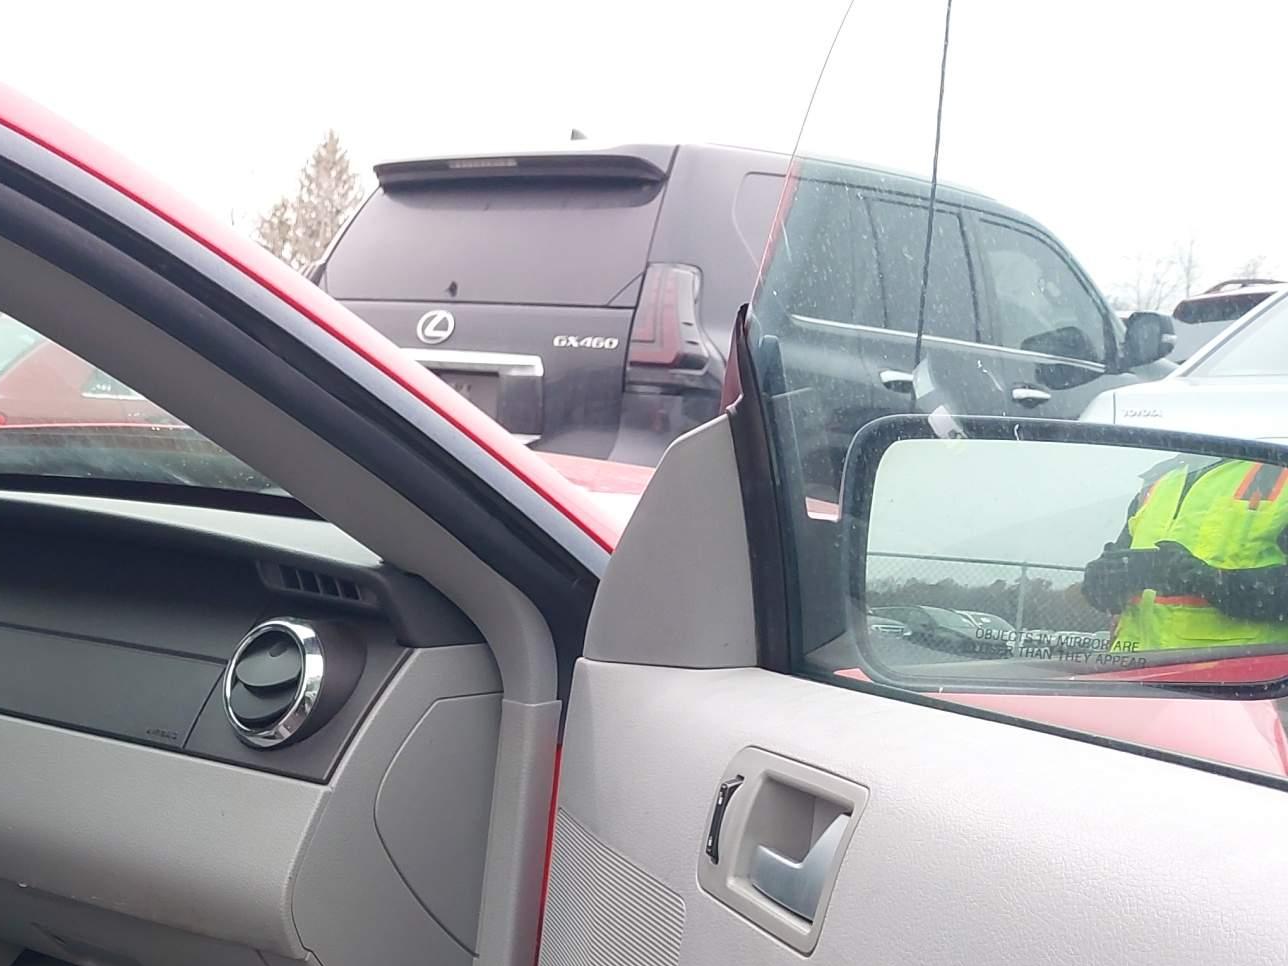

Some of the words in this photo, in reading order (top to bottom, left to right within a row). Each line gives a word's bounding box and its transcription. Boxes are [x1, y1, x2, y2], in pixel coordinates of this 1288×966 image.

[975, 628, 1034, 643] OBJECTS
[1039, 633, 1053, 645] IN
[1056, 635, 1110, 651] MIRROR
[1113, 640, 1140, 652] ARE
[1018, 646, 1052, 660] THAN
[1058, 651, 1091, 664] THEY
[1095, 654, 1146, 668] APPEAR
